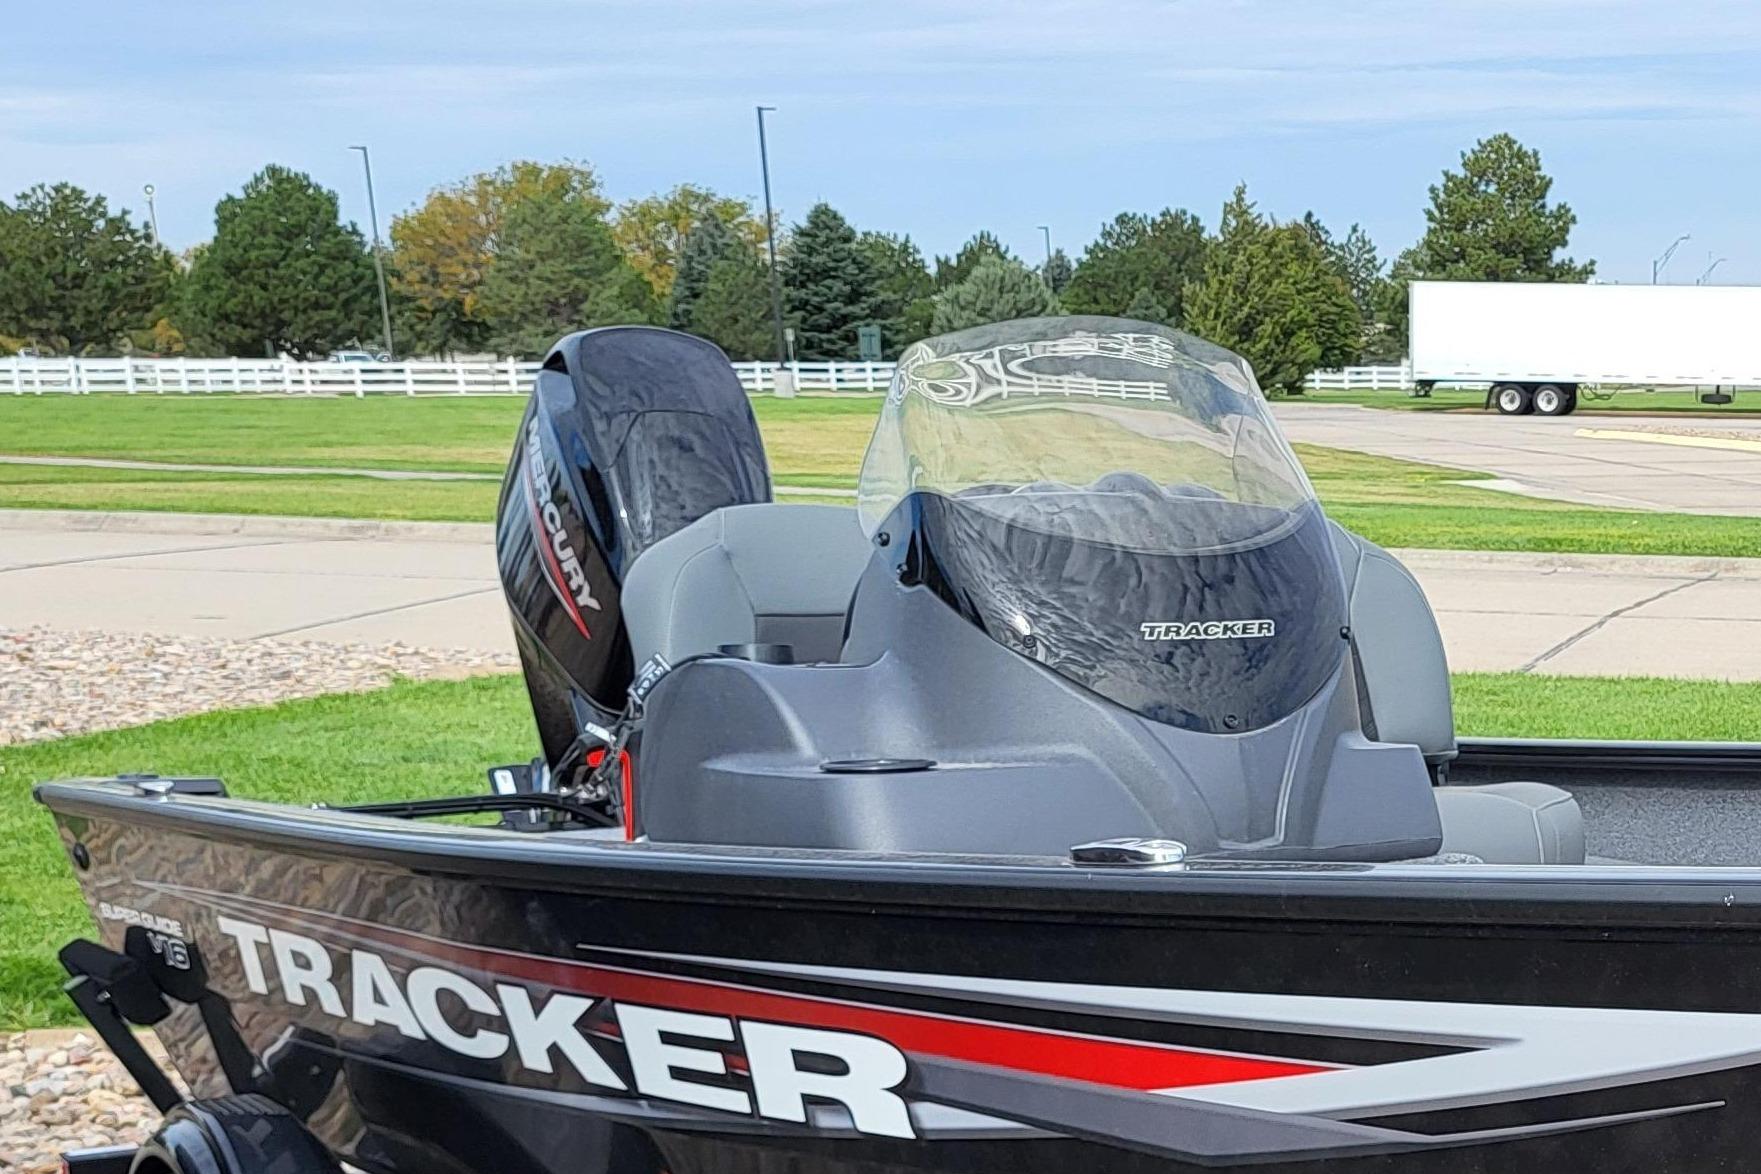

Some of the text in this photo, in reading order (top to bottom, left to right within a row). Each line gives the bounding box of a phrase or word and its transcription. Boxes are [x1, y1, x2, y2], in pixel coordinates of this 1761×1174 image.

[528, 416, 602, 611] MERCURY
[1140, 619, 1275, 640] TRACKER
[217, 916, 917, 1140] TRACKER
